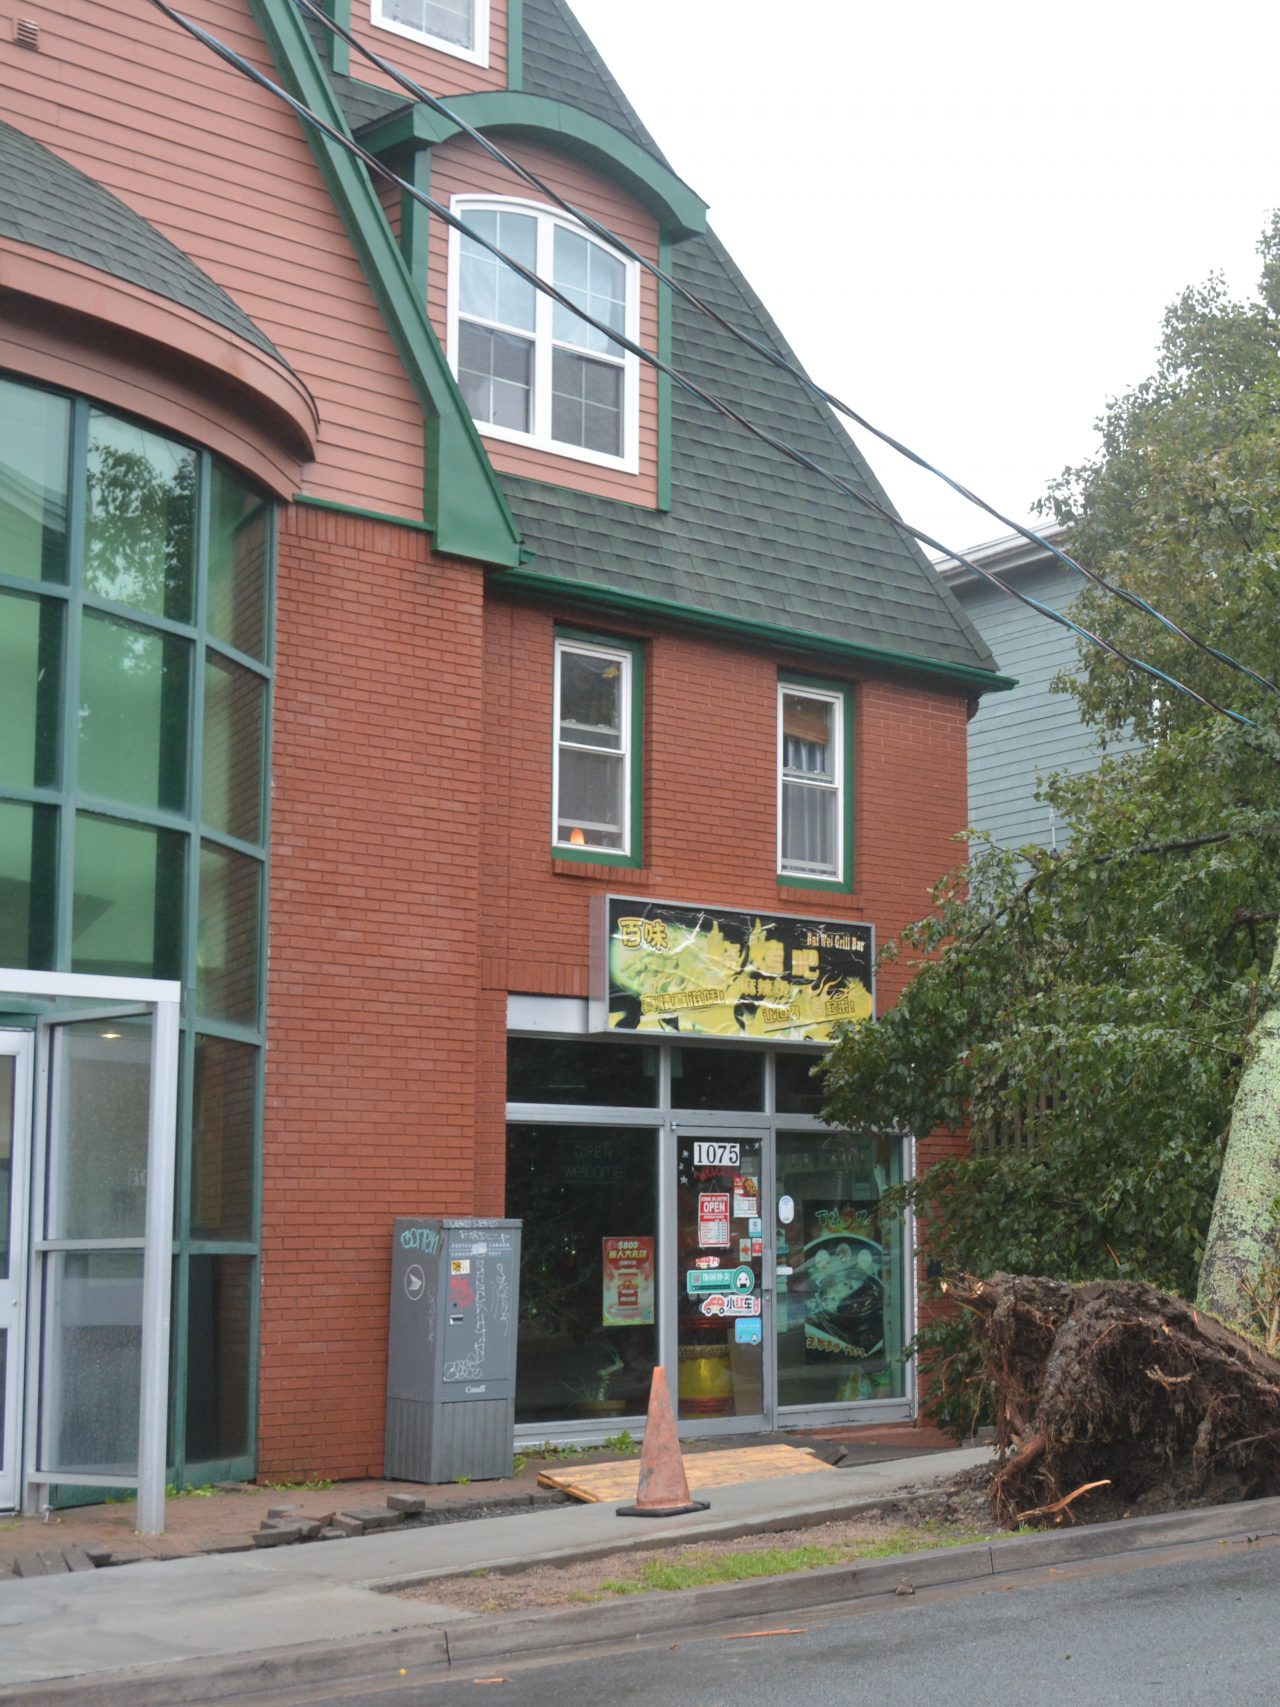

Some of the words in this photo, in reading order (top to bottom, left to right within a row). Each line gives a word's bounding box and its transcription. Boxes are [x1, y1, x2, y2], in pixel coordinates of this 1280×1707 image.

[619, 918, 669, 951] 百味
[806, 931, 819, 946] Bai
[820, 933, 833, 948] Wei
[835, 935, 850, 951] Grill
[851, 937, 866, 953] Bar
[697, 1144, 739, 1164] 1075
[703, 1201, 726, 1214] OPEN
[726, 1297, 752, 1310] 小红车
